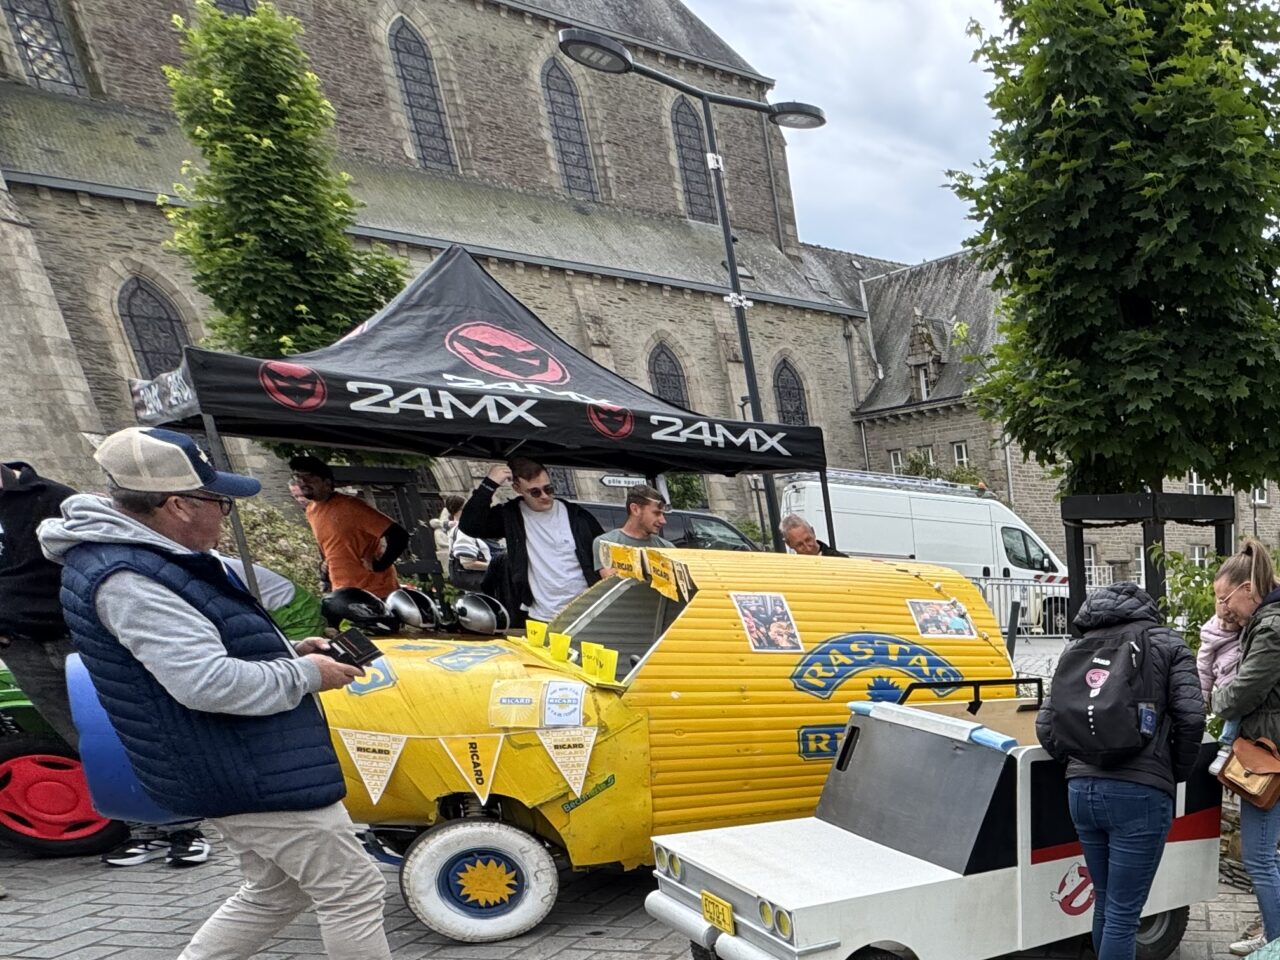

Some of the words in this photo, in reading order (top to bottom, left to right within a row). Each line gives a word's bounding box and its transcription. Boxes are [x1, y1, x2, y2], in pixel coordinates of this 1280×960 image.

[346, 381, 548, 428] 24MX
[650, 415, 793, 457] 24MX
[802, 640, 956, 690] RASTAS
[500, 697, 532, 705] RICARD
[356, 746, 391, 756] RICARD
[468, 741, 485, 786] RICARD
